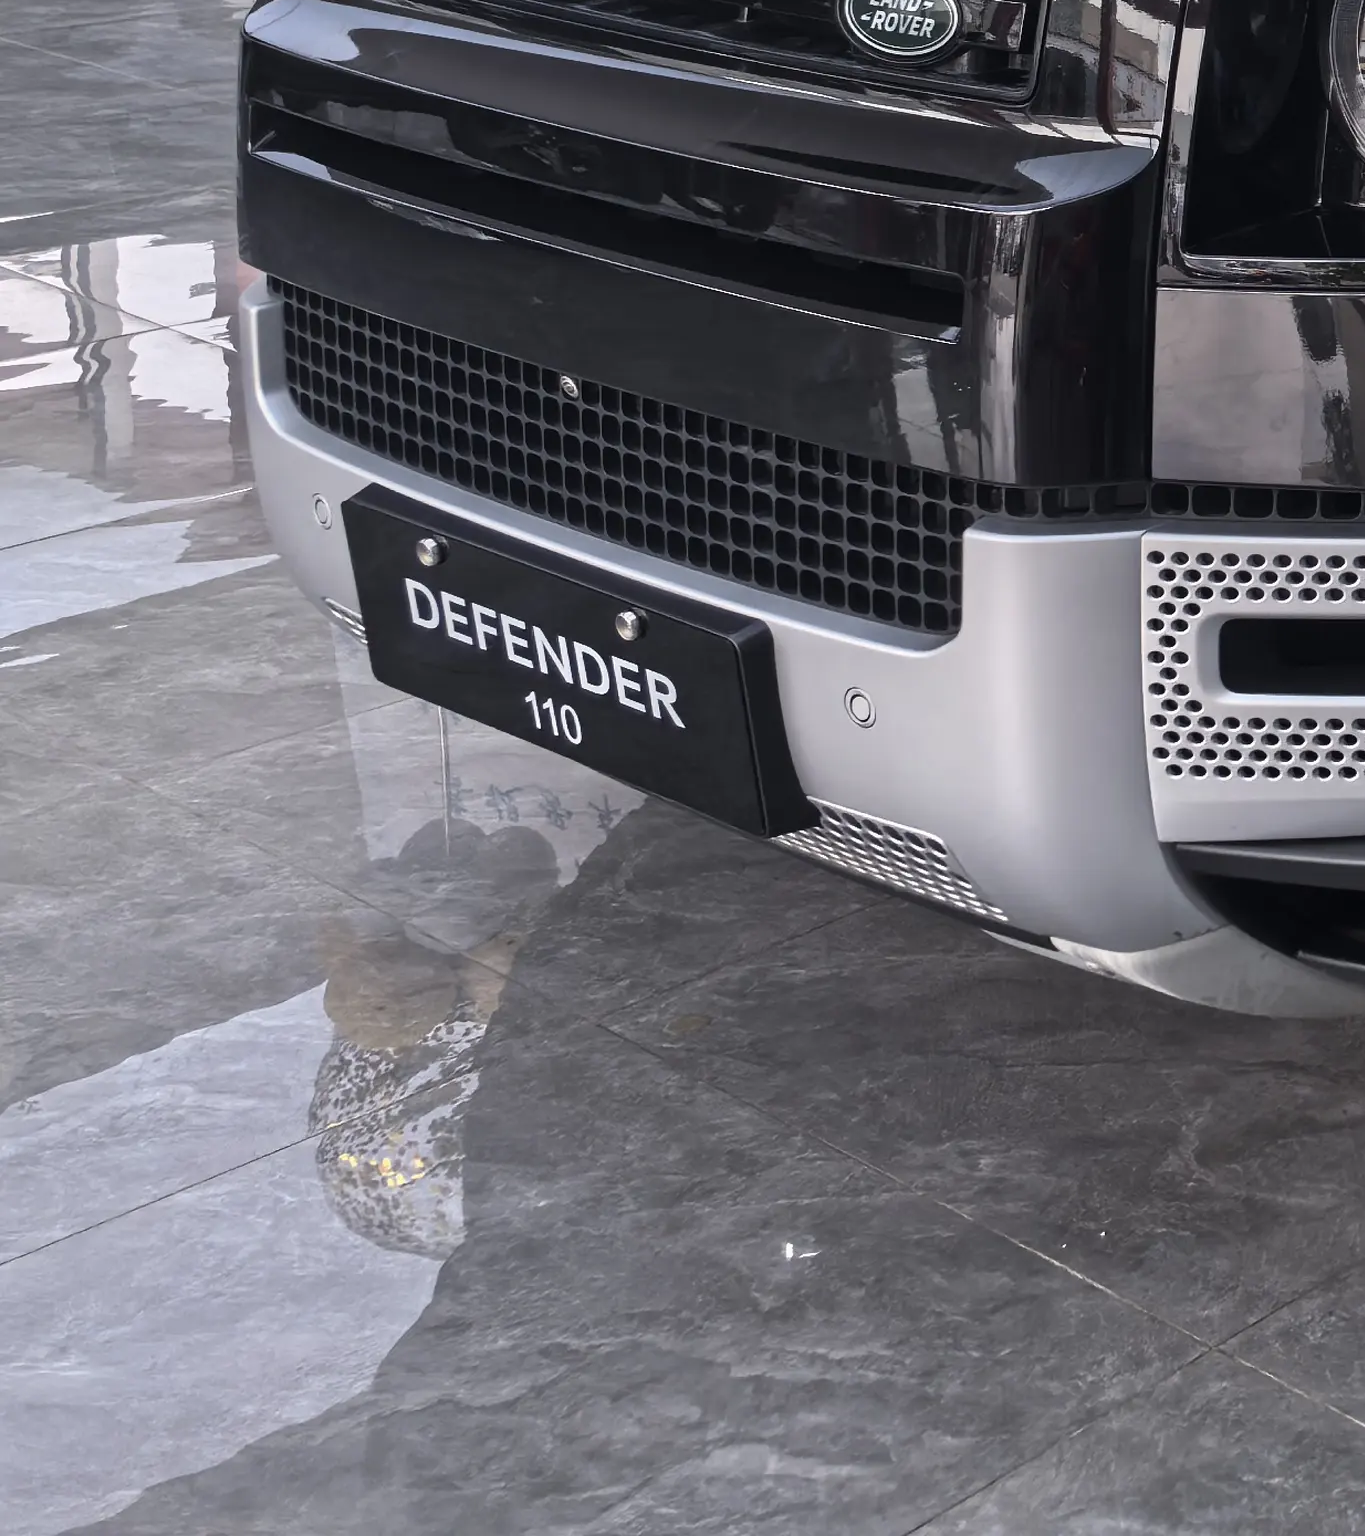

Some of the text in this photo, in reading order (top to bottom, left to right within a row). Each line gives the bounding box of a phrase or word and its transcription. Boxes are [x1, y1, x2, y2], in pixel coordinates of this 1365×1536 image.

[869, 9, 936, 39] ROVER
[403, 576, 686, 730] DEFENDER
[524, 690, 583, 746] 110
